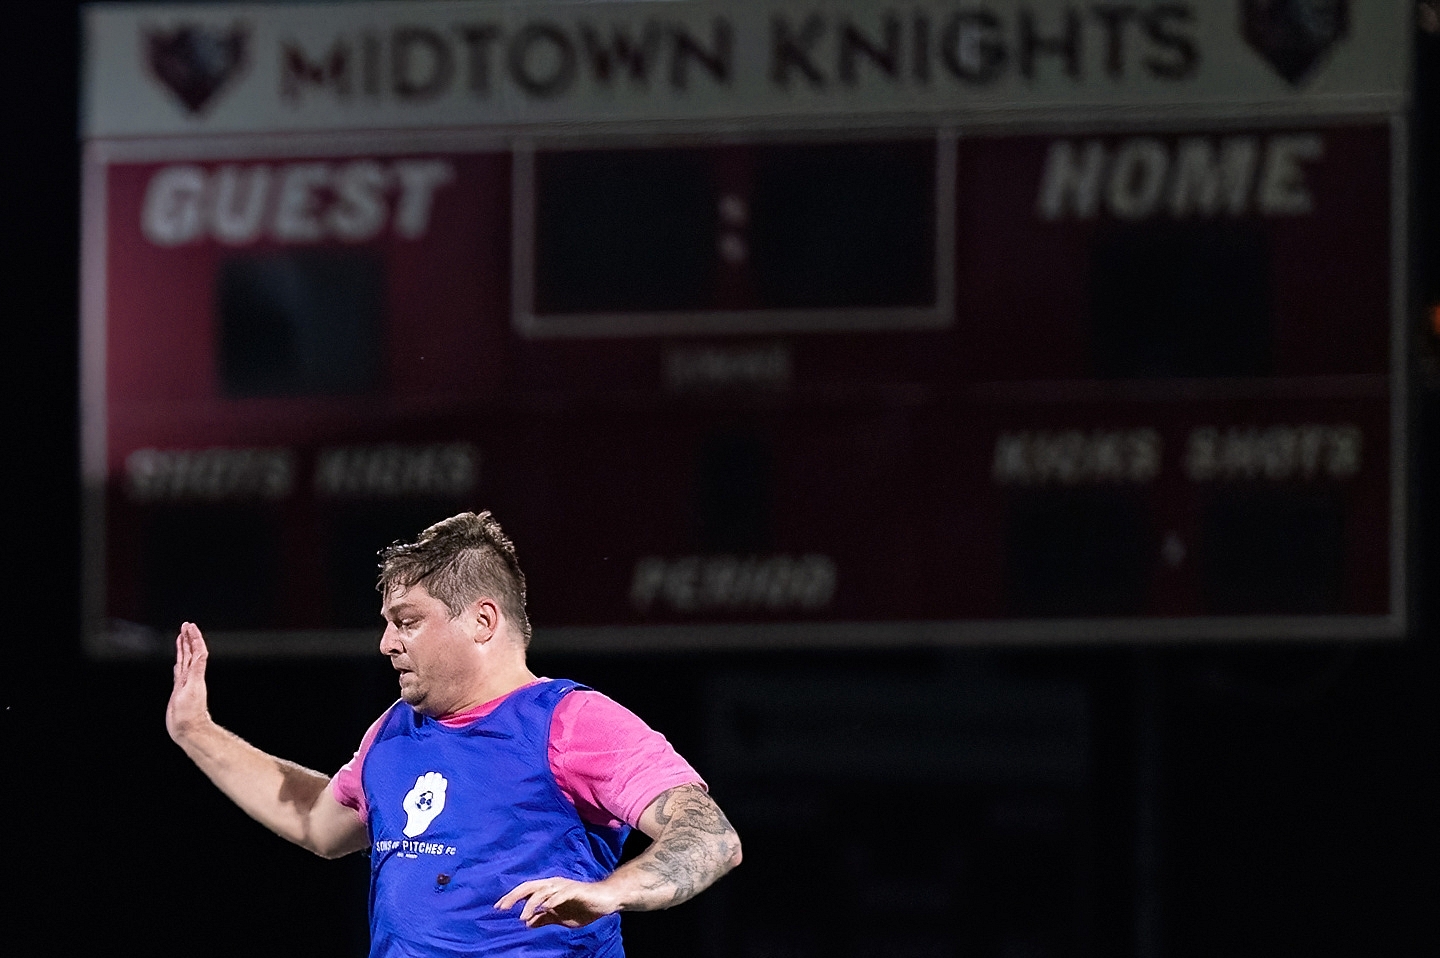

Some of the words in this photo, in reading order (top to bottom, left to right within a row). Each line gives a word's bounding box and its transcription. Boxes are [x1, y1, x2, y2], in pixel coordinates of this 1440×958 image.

[278, 18, 733, 101] MIDTOWN
[771, 4, 1202, 88] KNIGHTS
[140, 157, 455, 247] GUEST
[1037, 132, 1328, 222] HOME
[991, 427, 1163, 487] KICKS
[1184, 423, 1362, 483] SHOTS
[630, 553, 838, 612] PERIOD
[402, 840, 444, 856] PITCHES
